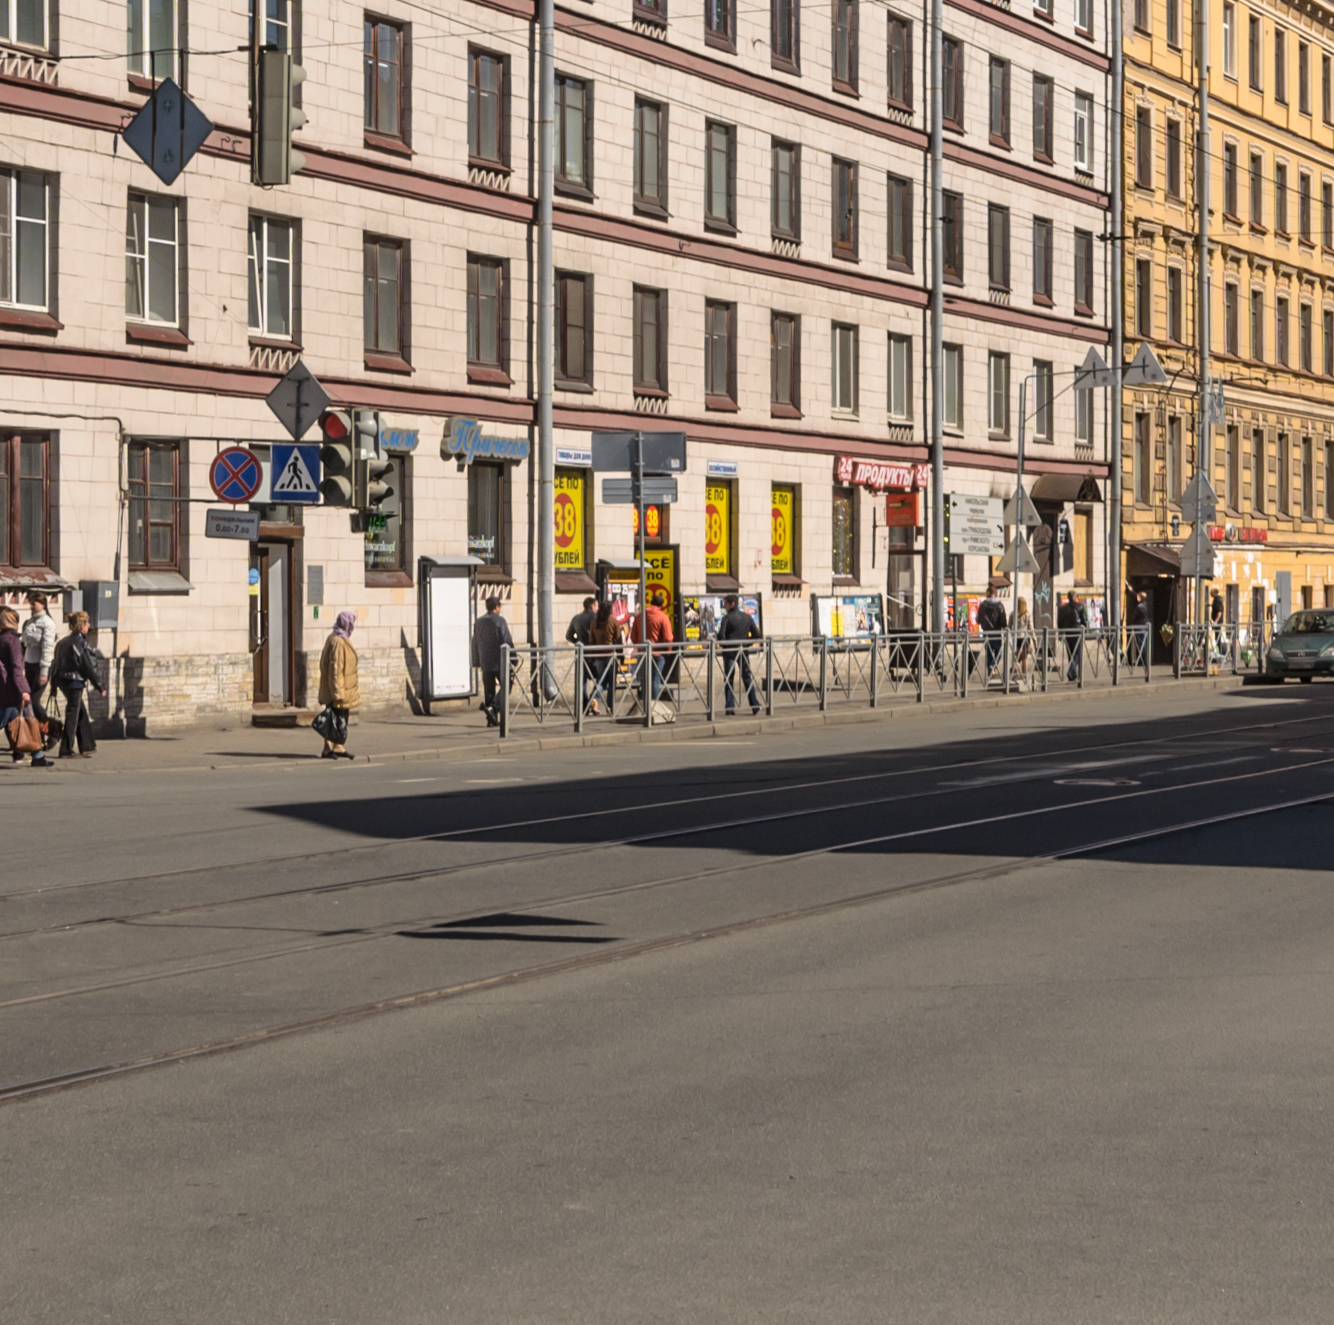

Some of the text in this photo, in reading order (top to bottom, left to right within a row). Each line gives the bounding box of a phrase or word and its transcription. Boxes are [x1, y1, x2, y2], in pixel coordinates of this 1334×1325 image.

[840, 457, 853, 473] 24
[855, 463, 915, 487] ПРОДУКТЫ
[917, 465, 928, 480] 24
[555, 502, 575, 537] 38
[647, 509, 658, 527] 38
[647, 572, 664, 580] по
